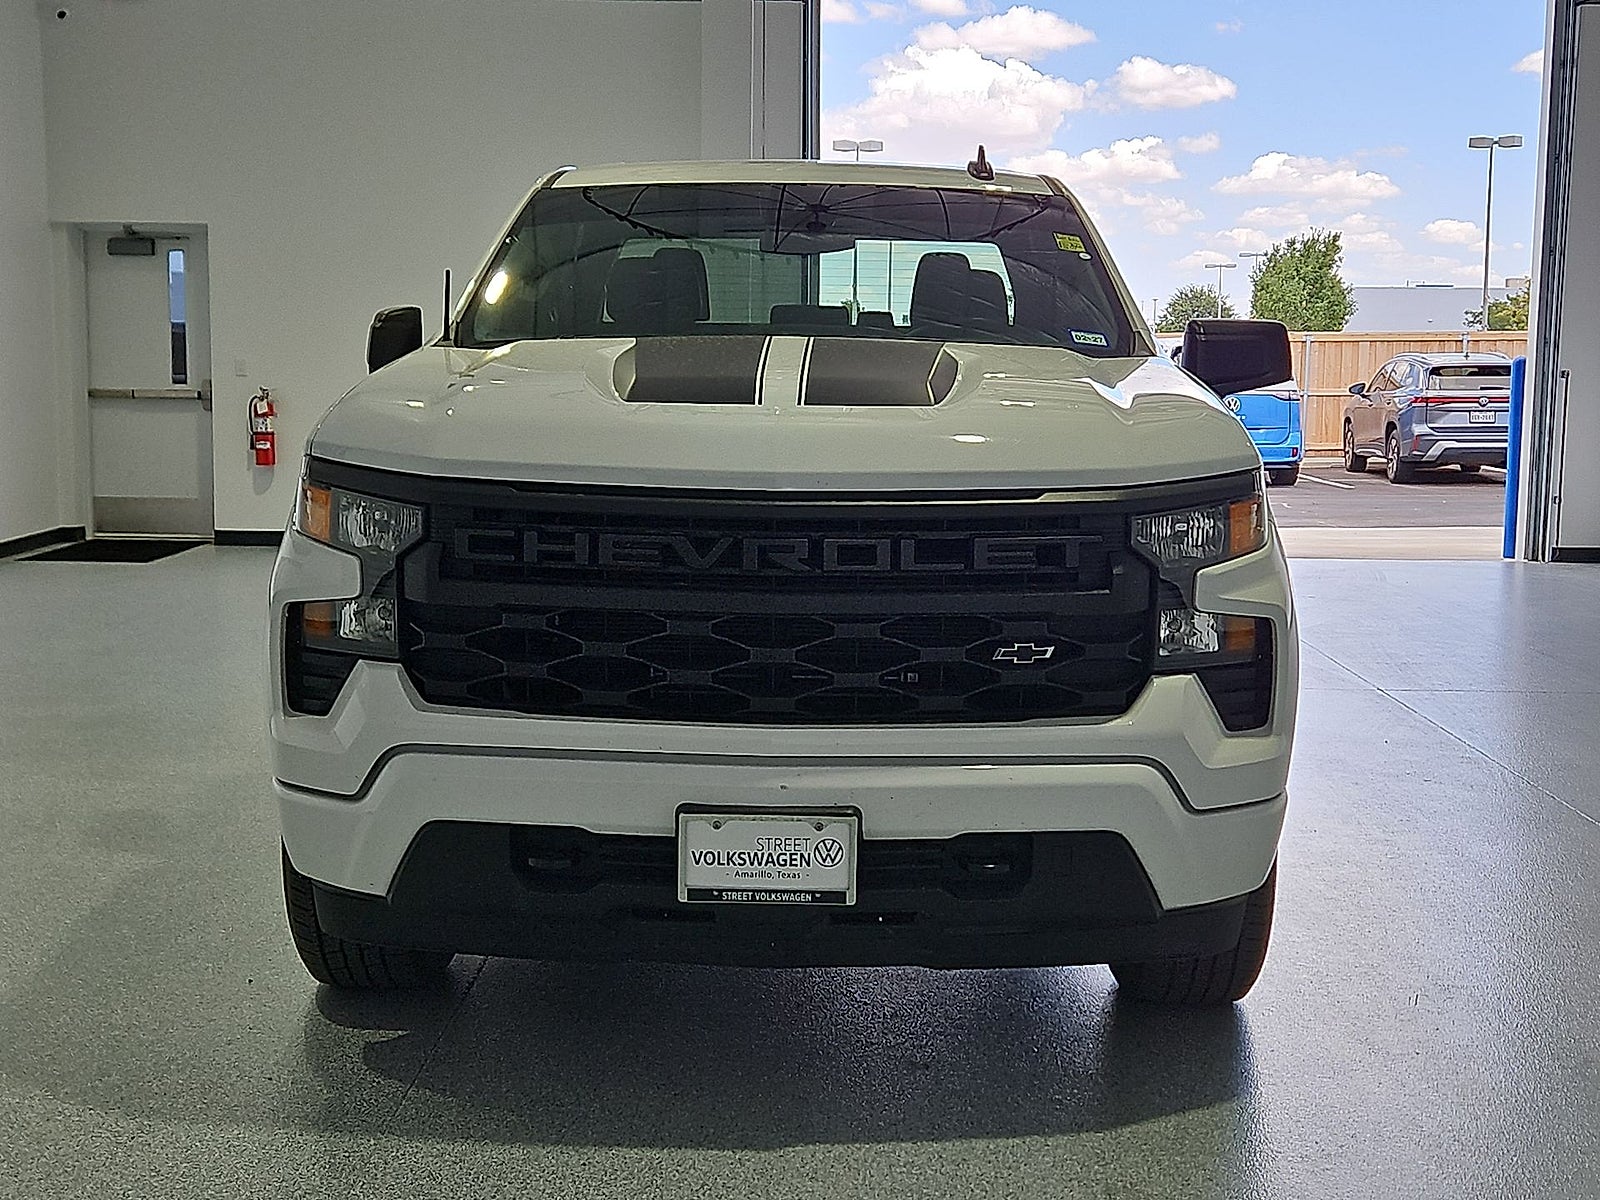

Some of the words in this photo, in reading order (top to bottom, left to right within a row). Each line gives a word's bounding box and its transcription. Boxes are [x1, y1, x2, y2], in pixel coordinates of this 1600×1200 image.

[454, 529, 1103, 573] CHEVROLET
[756, 837, 811, 852] STREET
[690, 850, 811, 868] VOLKSWAGEN
[734, 869, 775, 879] Amarillo,
[777, 870, 801, 879] Texas
[722, 891, 753, 900] STREET
[755, 892, 812, 902] VOLKSWAGEN
